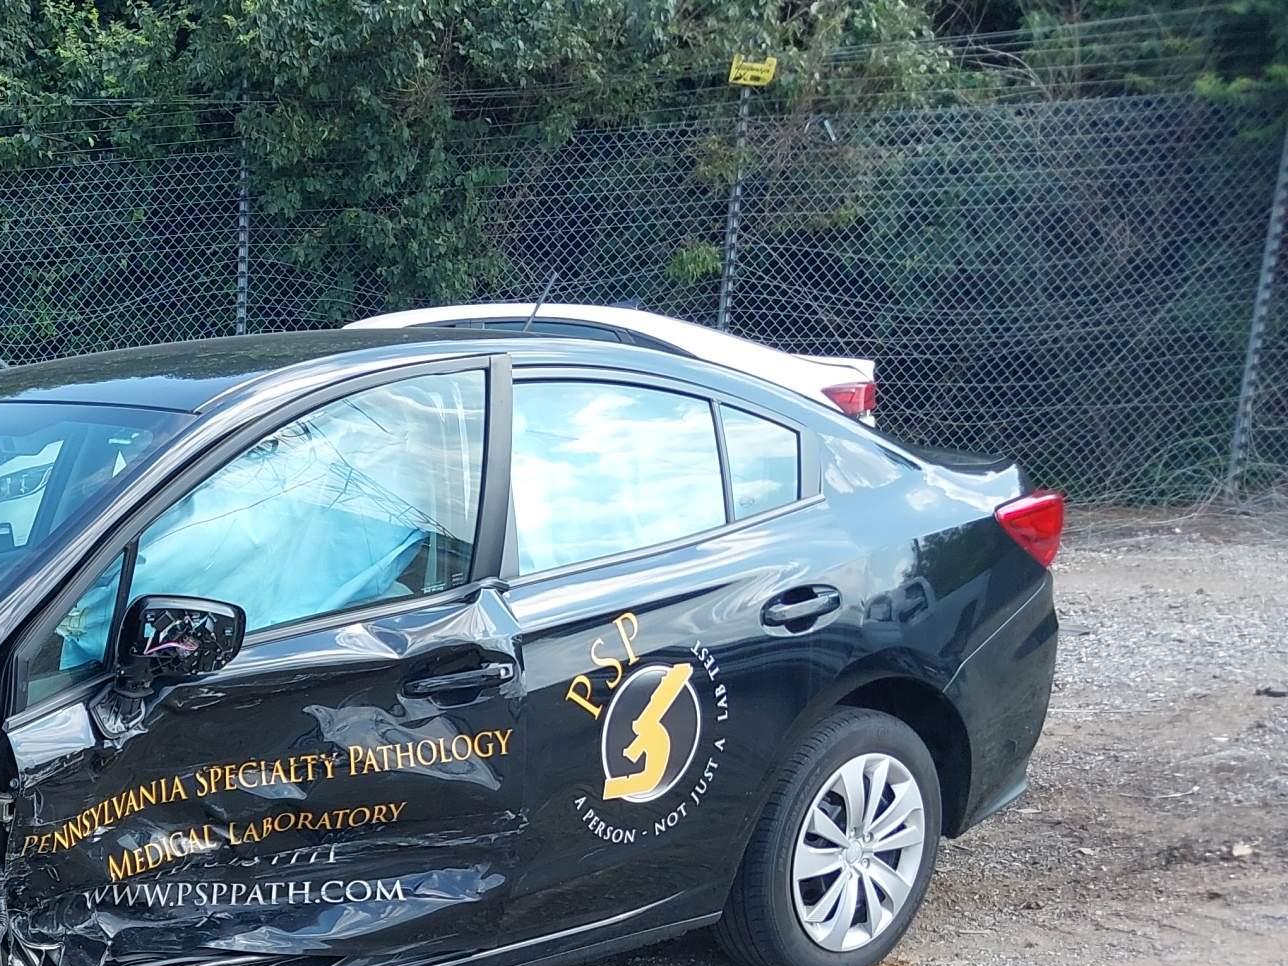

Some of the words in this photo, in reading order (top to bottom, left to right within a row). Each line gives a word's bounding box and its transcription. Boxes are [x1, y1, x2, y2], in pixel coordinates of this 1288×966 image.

[565, 612, 639, 720] PSP
[690, 640, 721, 681] TEST
[714, 684, 728, 721] LAB
[714, 738, 726, 752] A
[21, 775, 189, 857] PENNSYLVANIA
[195, 753, 338, 797] SPECIALTY
[348, 729, 513, 776] PATHOLOGY
[690, 758, 719, 804] JUST
[574, 796, 586, 810] A
[653, 802, 688, 836] NOT
[108, 824, 216, 881] MEDICAL
[228, 801, 408, 845] LABORATORY
[582, 808, 636, 844] PERSON
[83, 879, 408, 909] WWW.PSPPATH.COM
